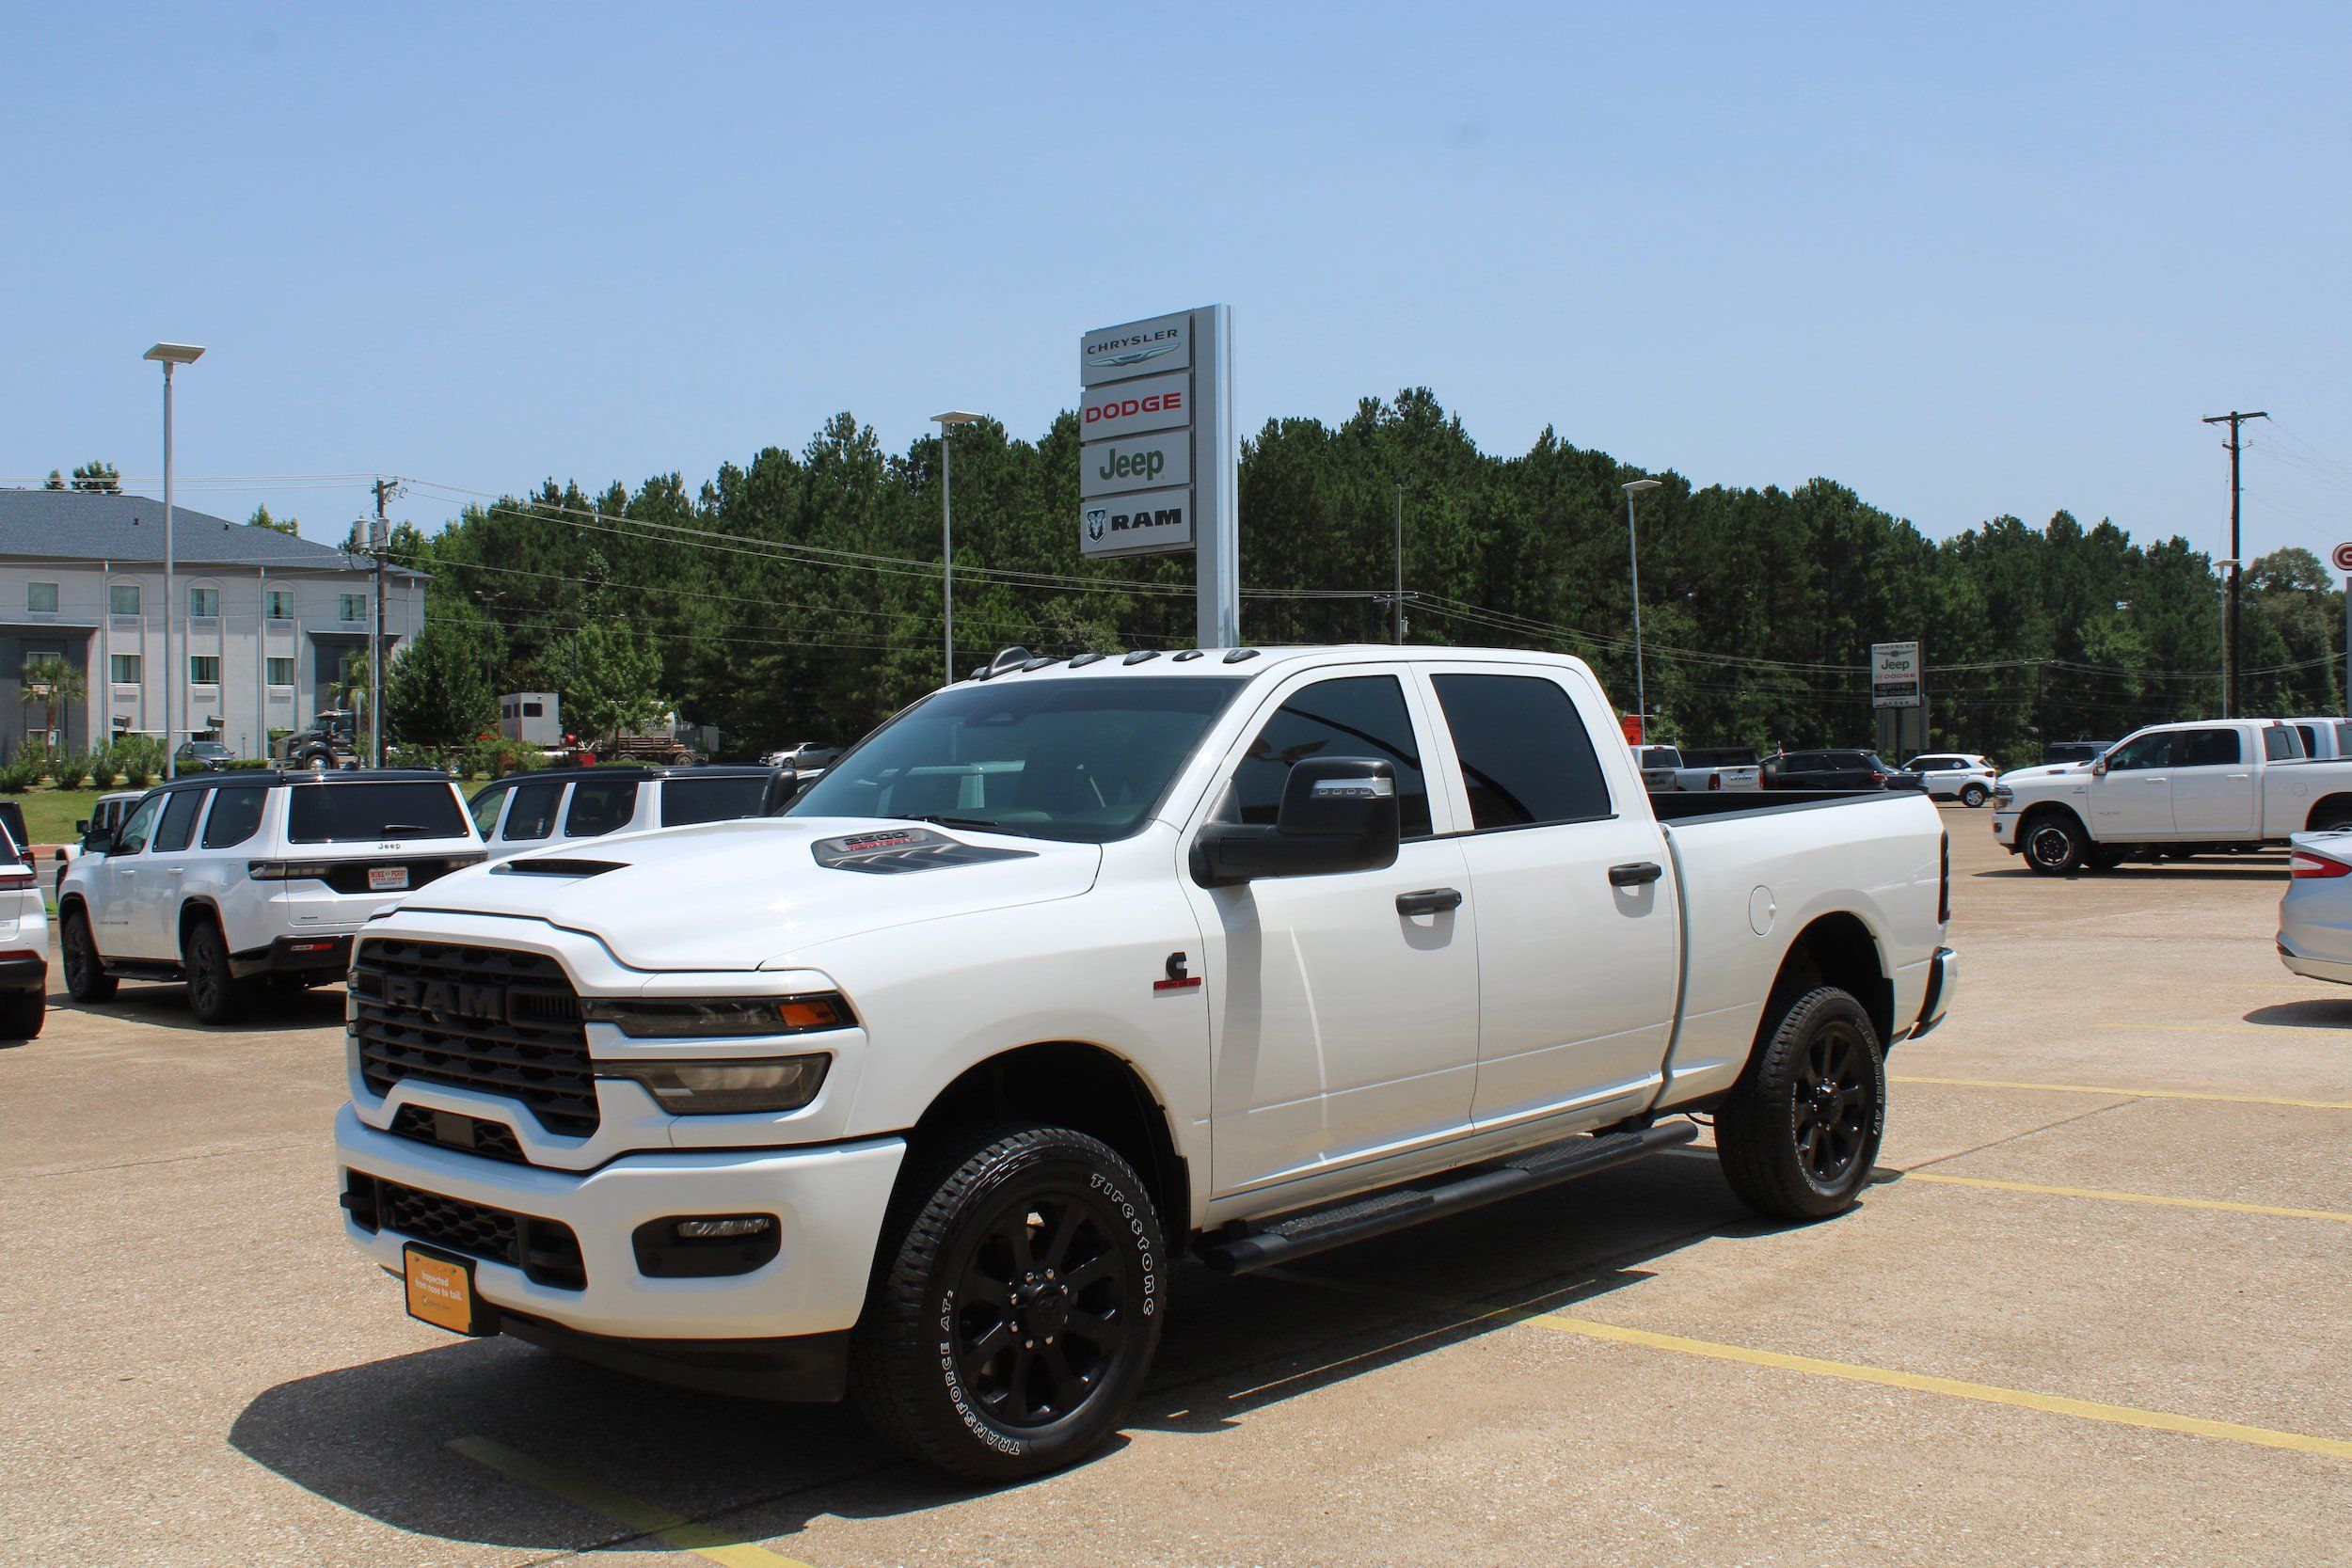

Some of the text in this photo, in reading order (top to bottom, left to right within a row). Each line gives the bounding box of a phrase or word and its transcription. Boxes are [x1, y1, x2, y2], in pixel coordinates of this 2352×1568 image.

[1087, 329, 1179, 356] CHRYSLER
[1085, 391, 1182, 424] DODGE
[1099, 448, 1165, 482] Jeep
[1111, 508, 1182, 531] RAM
[1882, 658, 1910, 671] Jeep
[844, 832, 910, 846] 2500
[387, 975, 503, 1022] RAM
[1089, 1173, 1155, 1316] Firestone
[940, 1341, 1021, 1455] TRANSFORCE
